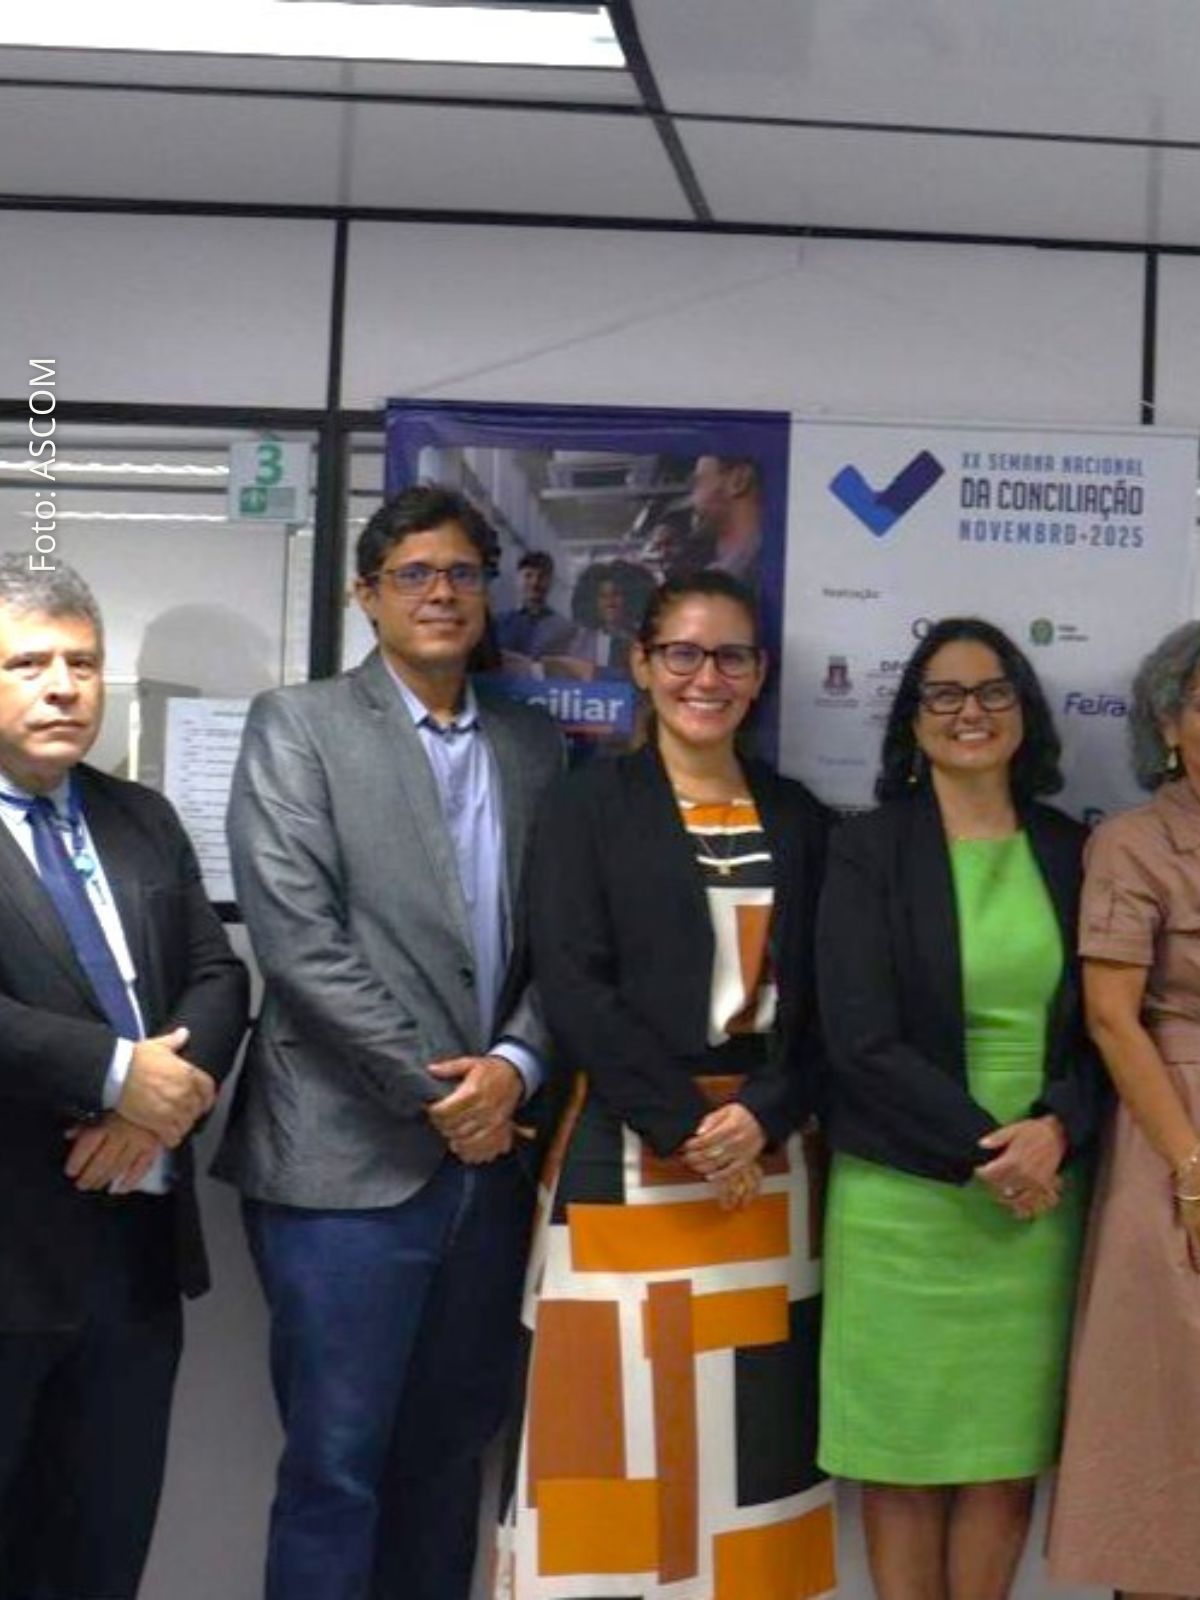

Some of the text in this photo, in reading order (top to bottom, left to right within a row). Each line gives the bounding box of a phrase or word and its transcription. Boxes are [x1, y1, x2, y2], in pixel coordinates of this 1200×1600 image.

[256, 443, 282, 486] 3
[988, 453, 1055, 472] SEMANA
[1061, 455, 1144, 476] NACIONAL
[961, 477, 1144, 521] DA CONCILIAÇÃO
[1063, 691, 1127, 718] Feira
